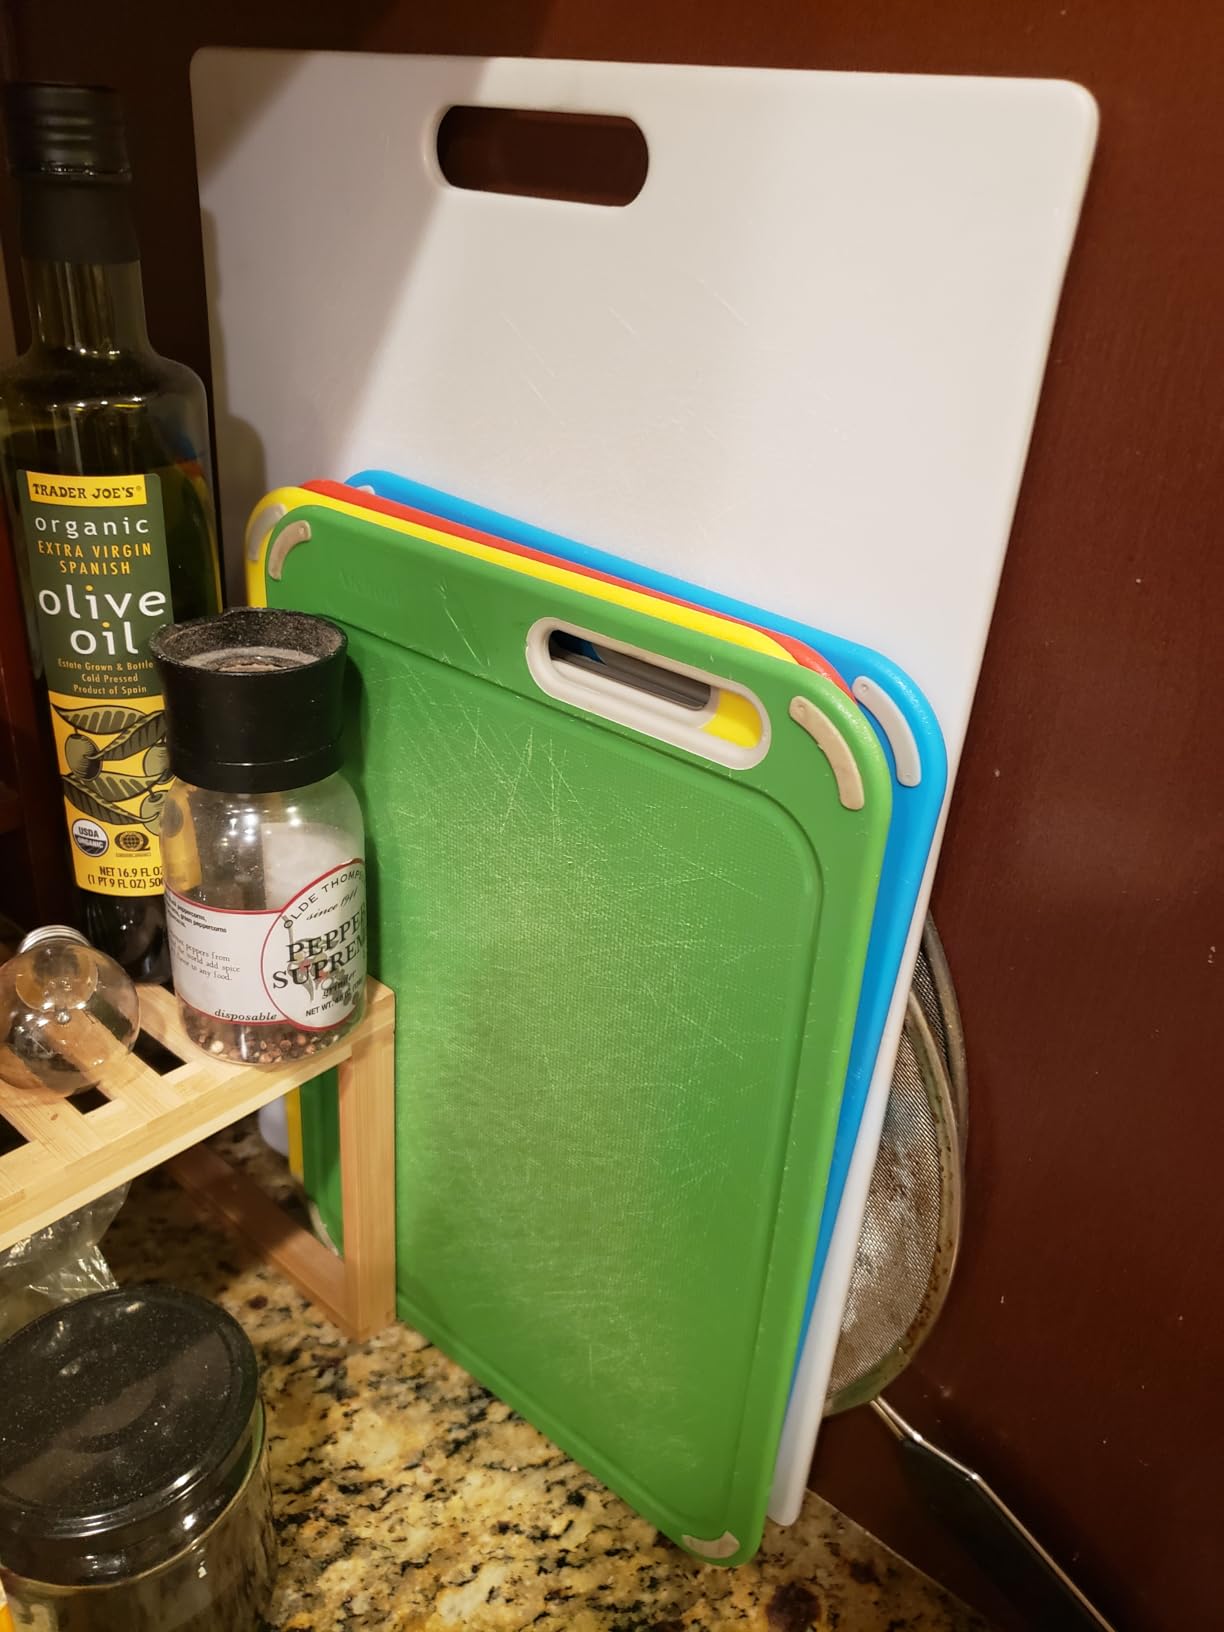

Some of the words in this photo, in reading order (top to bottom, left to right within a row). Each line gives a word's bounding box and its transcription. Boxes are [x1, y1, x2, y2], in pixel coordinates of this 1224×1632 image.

[32, 483, 87, 499] TRADER
[92, 486, 134, 499] JOE'S
[35, 516, 149, 539] organic
[38, 540, 84, 558] EXTRA
[92, 542, 152, 558] VIRGIN
[60, 560, 131, 576] SPANISH
[38, 584, 167, 620] olive
[70, 621, 139, 656] oil
[57, 658, 82, 670] Estate
[85, 662, 113, 671] Grown
[116, 663, 123, 671] &
[127, 659, 154, 671] Bottle
[81, 673, 100, 682] Cold
[103, 672, 139, 683] Pressed
[73, 684, 106, 694] Product
[109, 686, 118, 694] of
[122, 685, 147, 696] Spain
[78, 826, 99, 838] USDA
[99, 866, 115, 877] NET
[117, 867, 138, 878] 16.9
[141, 868, 151, 877] FL
[98, 876, 108, 887] PT
[109, 878, 115, 888] 9
[117, 879, 128, 889] FL
[129, 878, 146, 889] OZ)
[283, 893, 319, 929] OLDE
[211, 951, 230, 962] from
[199, 968, 211, 978] any
[206, 959, 219, 969] add
[222, 965, 240, 974] spice
[213, 1008, 278, 1022] disposable
[305, 1006, 320, 1017] NET
